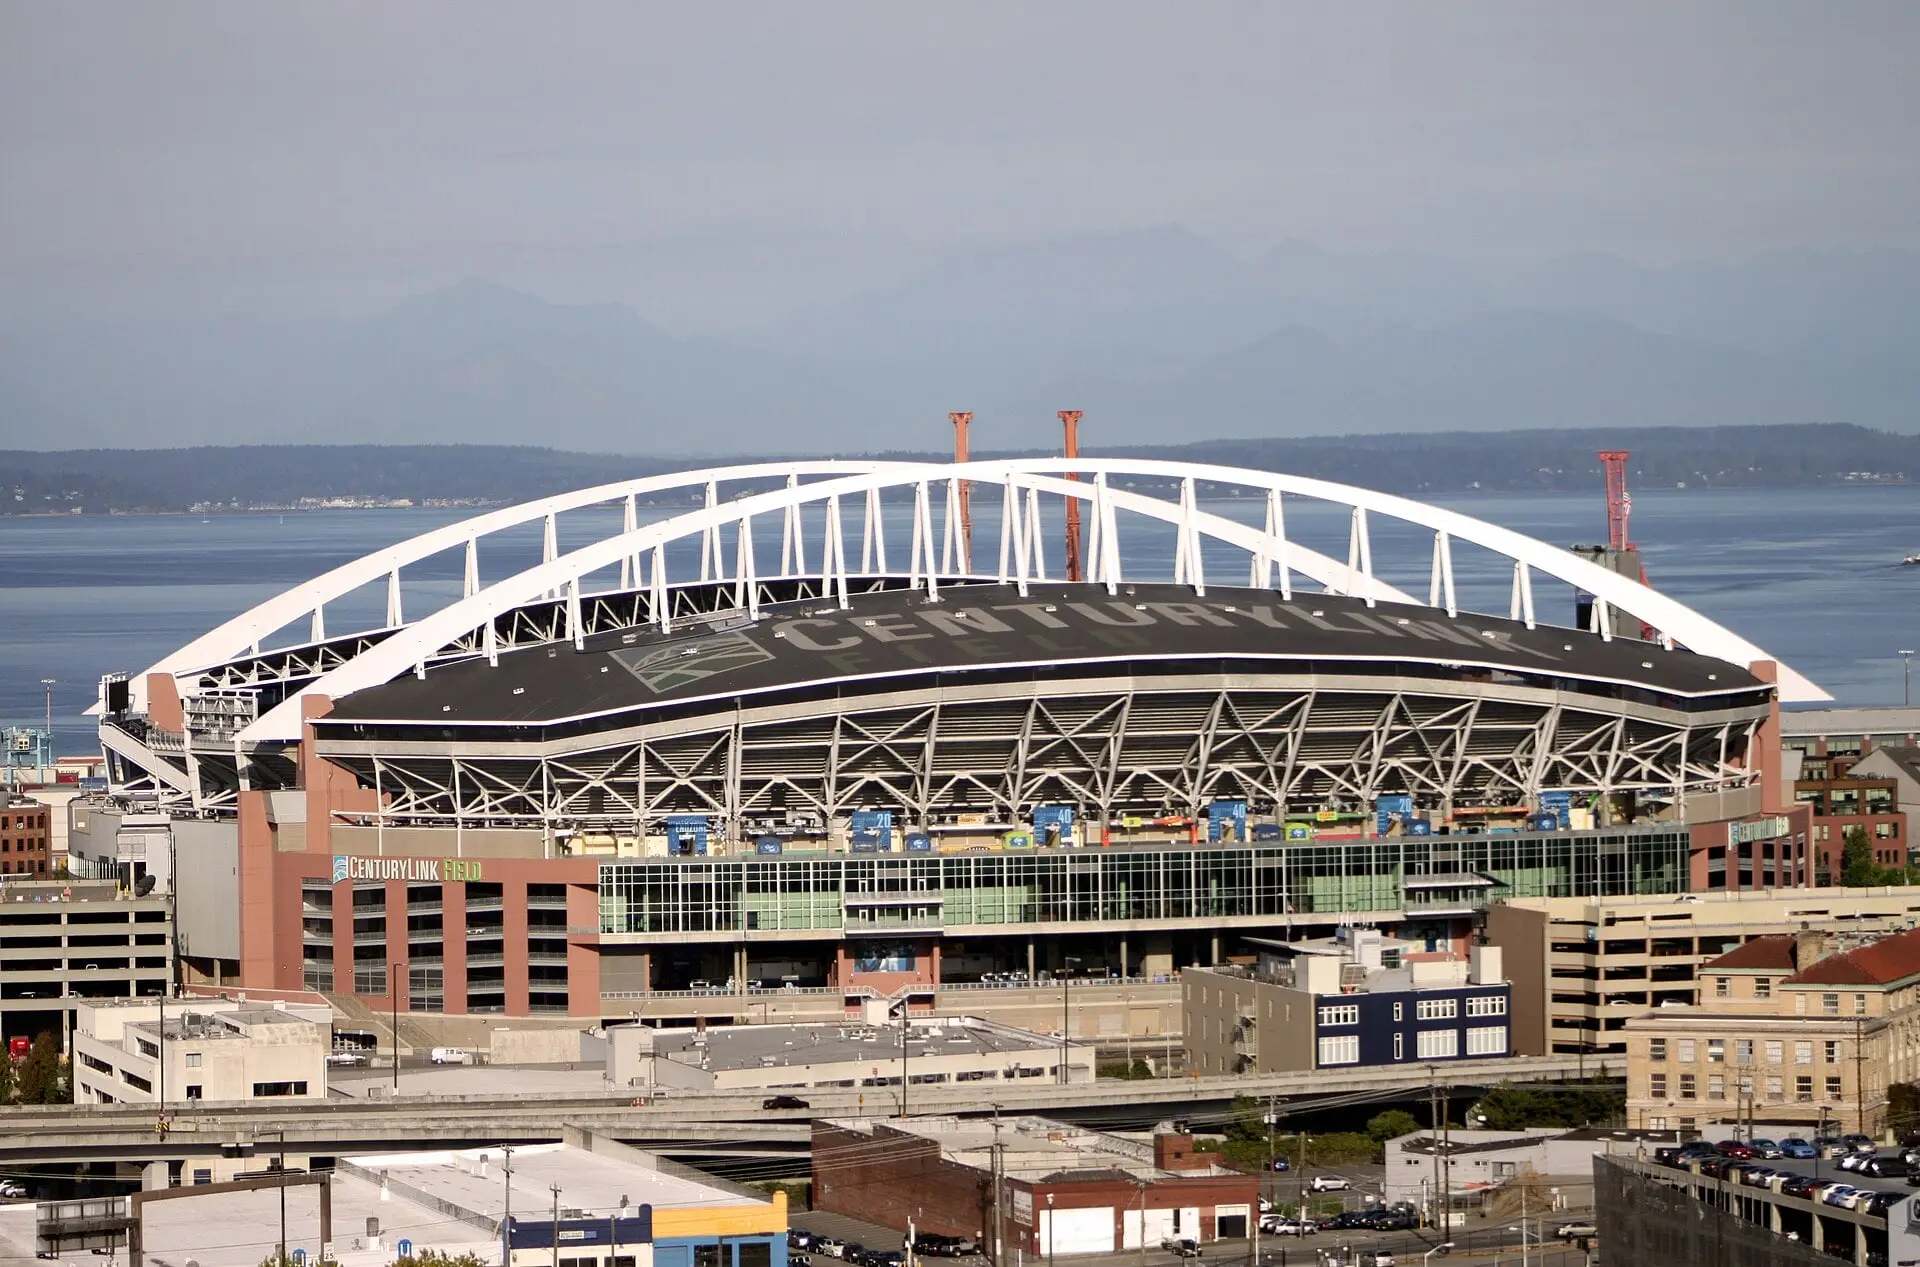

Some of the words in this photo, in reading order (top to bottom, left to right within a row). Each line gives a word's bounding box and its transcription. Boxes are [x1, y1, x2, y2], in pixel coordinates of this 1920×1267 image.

[772, 602, 1564, 661] CENTURYLINK
[820, 629, 1152, 673] FIELD
[1233, 803, 1246, 818] 40
[1399, 798, 1412, 812] 20
[876, 812, 891, 828] 20
[1057, 808, 1072, 824] 40
[350, 857, 439, 881] CENTURYLINK
[443, 859, 481, 882] FIELD
[325, 1252, 334, 1260] 25
